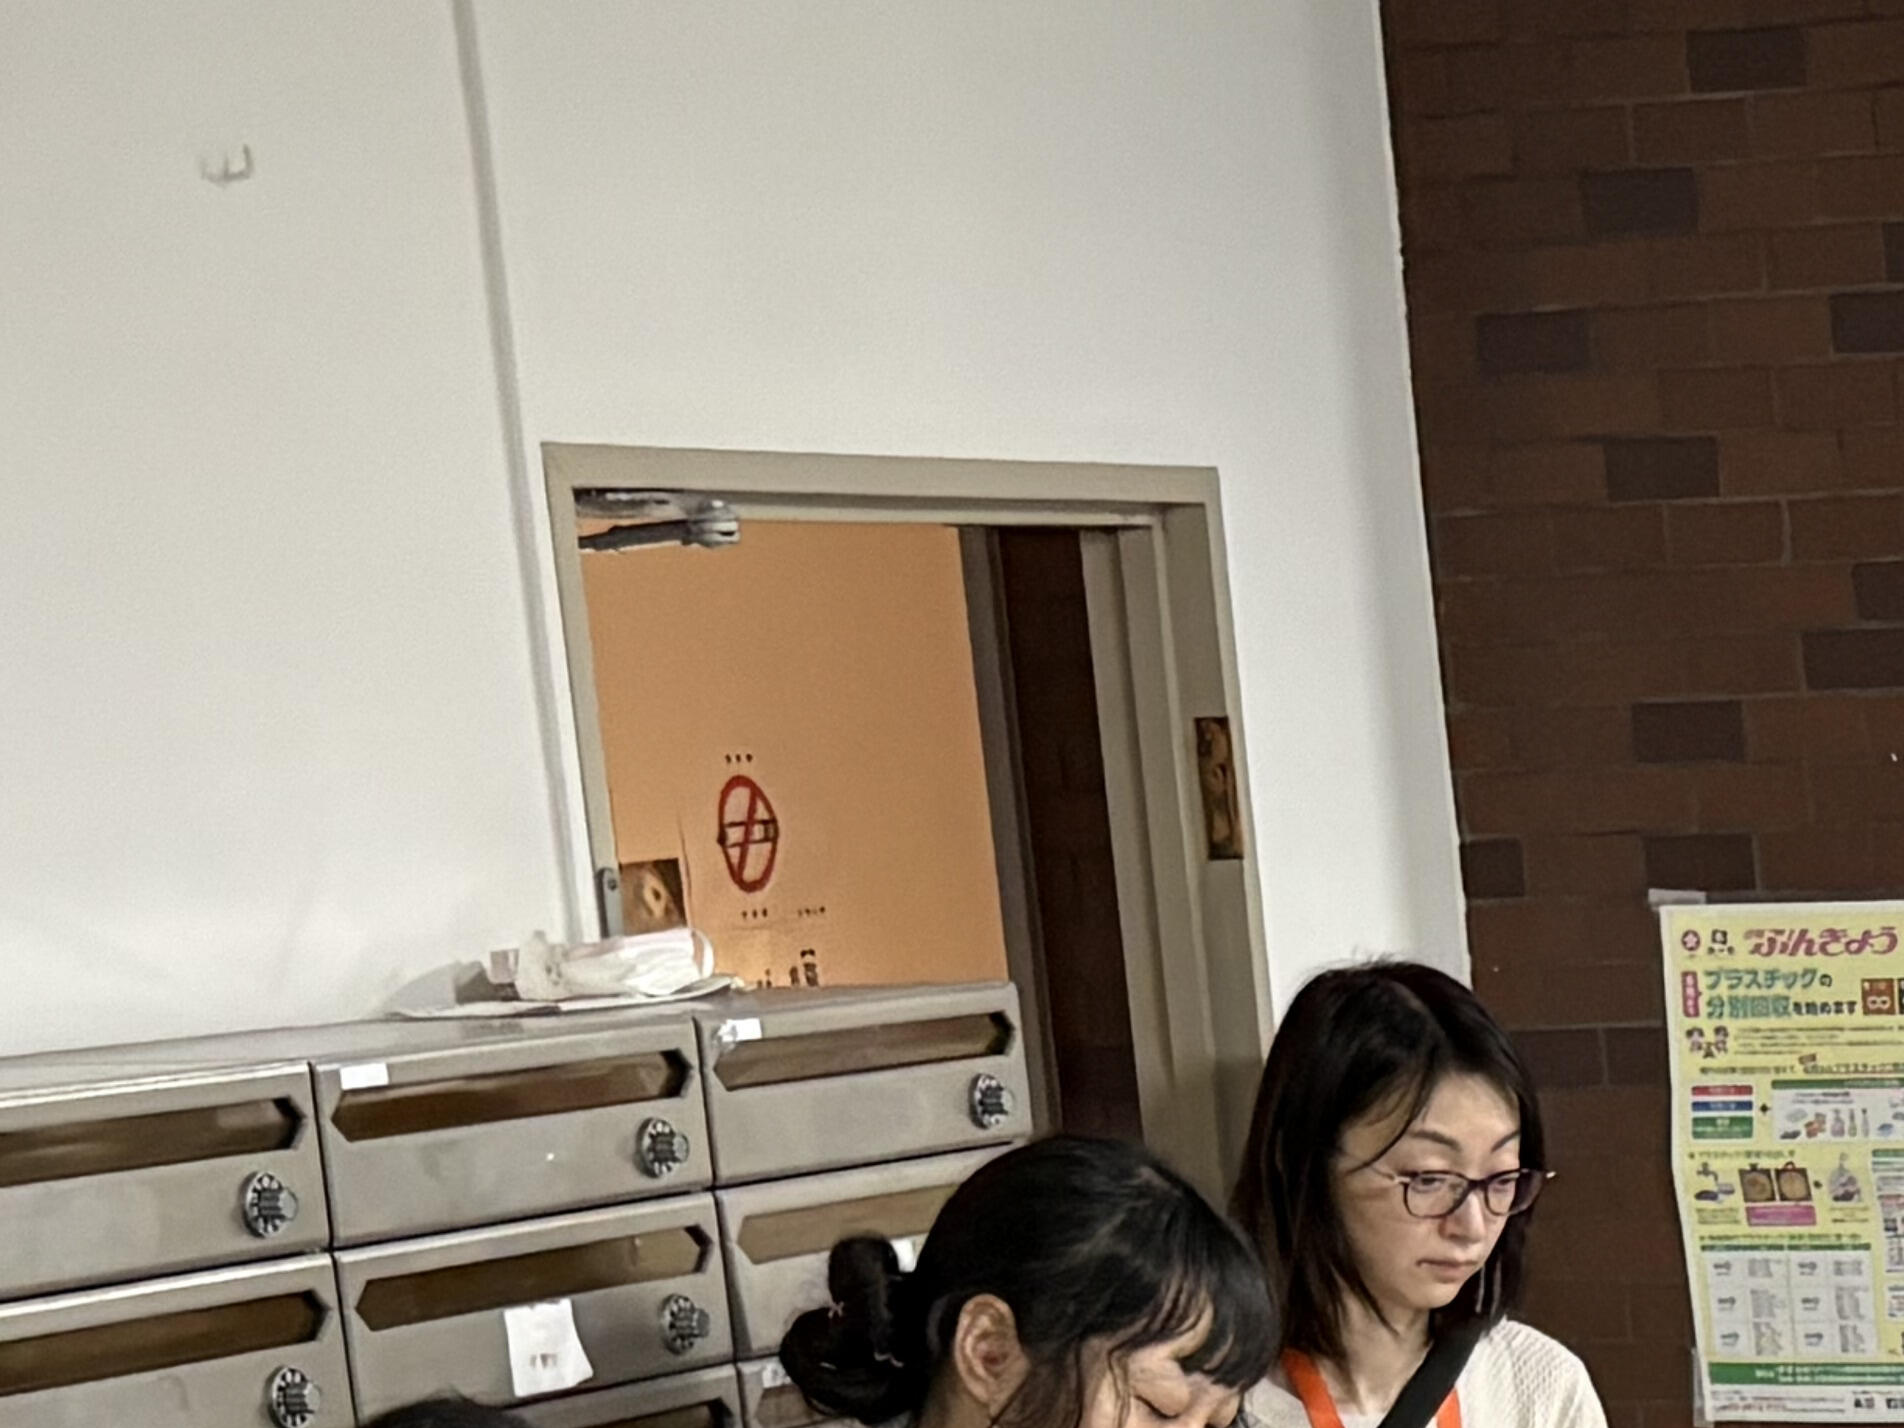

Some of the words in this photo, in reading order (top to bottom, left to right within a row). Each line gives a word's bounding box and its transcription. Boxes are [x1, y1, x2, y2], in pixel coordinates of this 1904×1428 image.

[1704, 968, 1833, 989] プラスチックの
